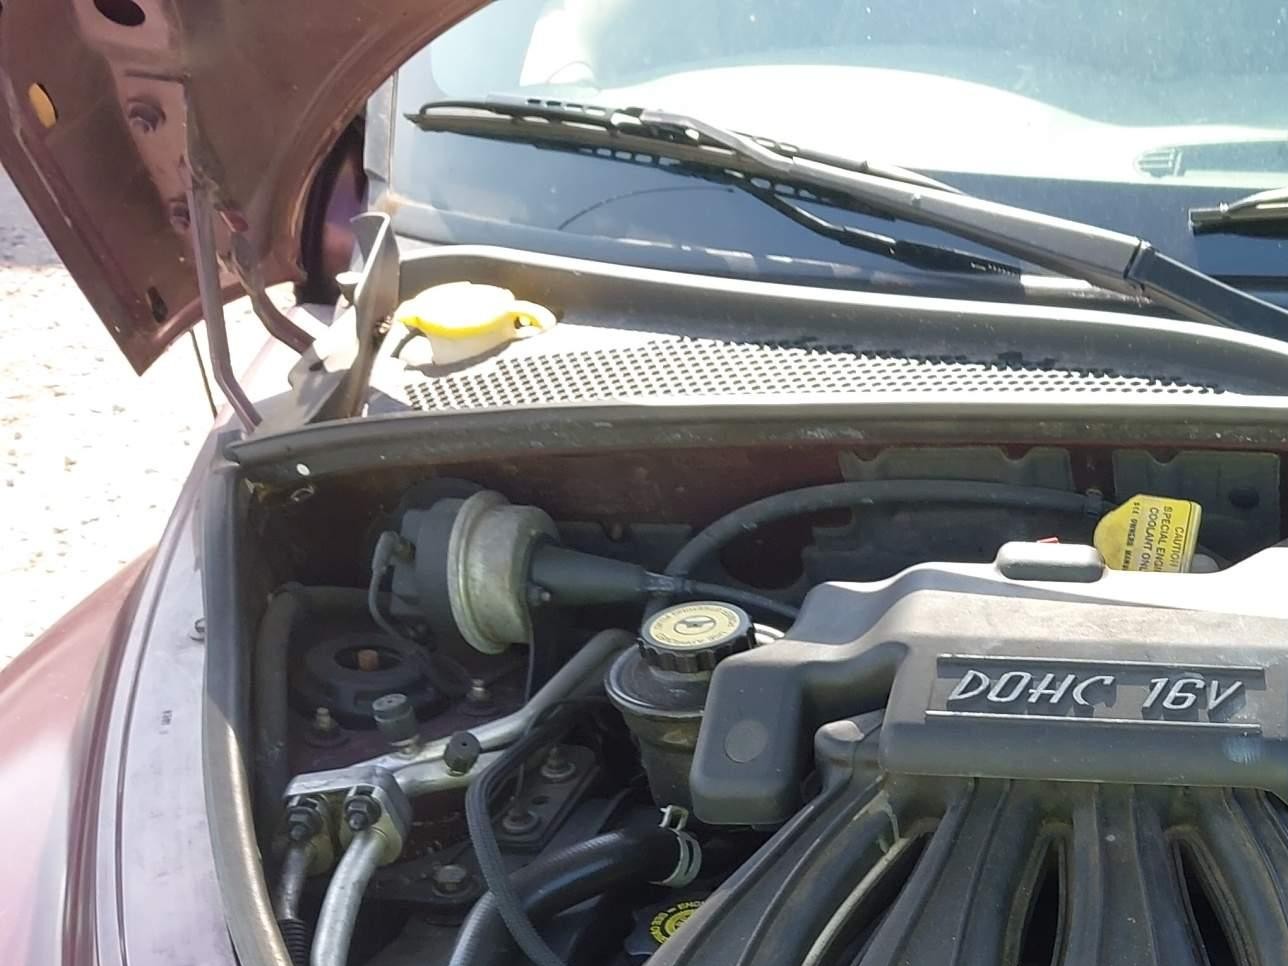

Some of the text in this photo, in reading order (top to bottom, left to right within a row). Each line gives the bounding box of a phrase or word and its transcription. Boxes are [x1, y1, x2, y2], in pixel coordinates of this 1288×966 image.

[1138, 507, 1159, 571] COOLANT ONL
[1153, 506, 1173, 571] SPECIAL ENGI
[1169, 526, 1184, 568] CAUTION
[947, 669, 1243, 712] DOHC 16V
